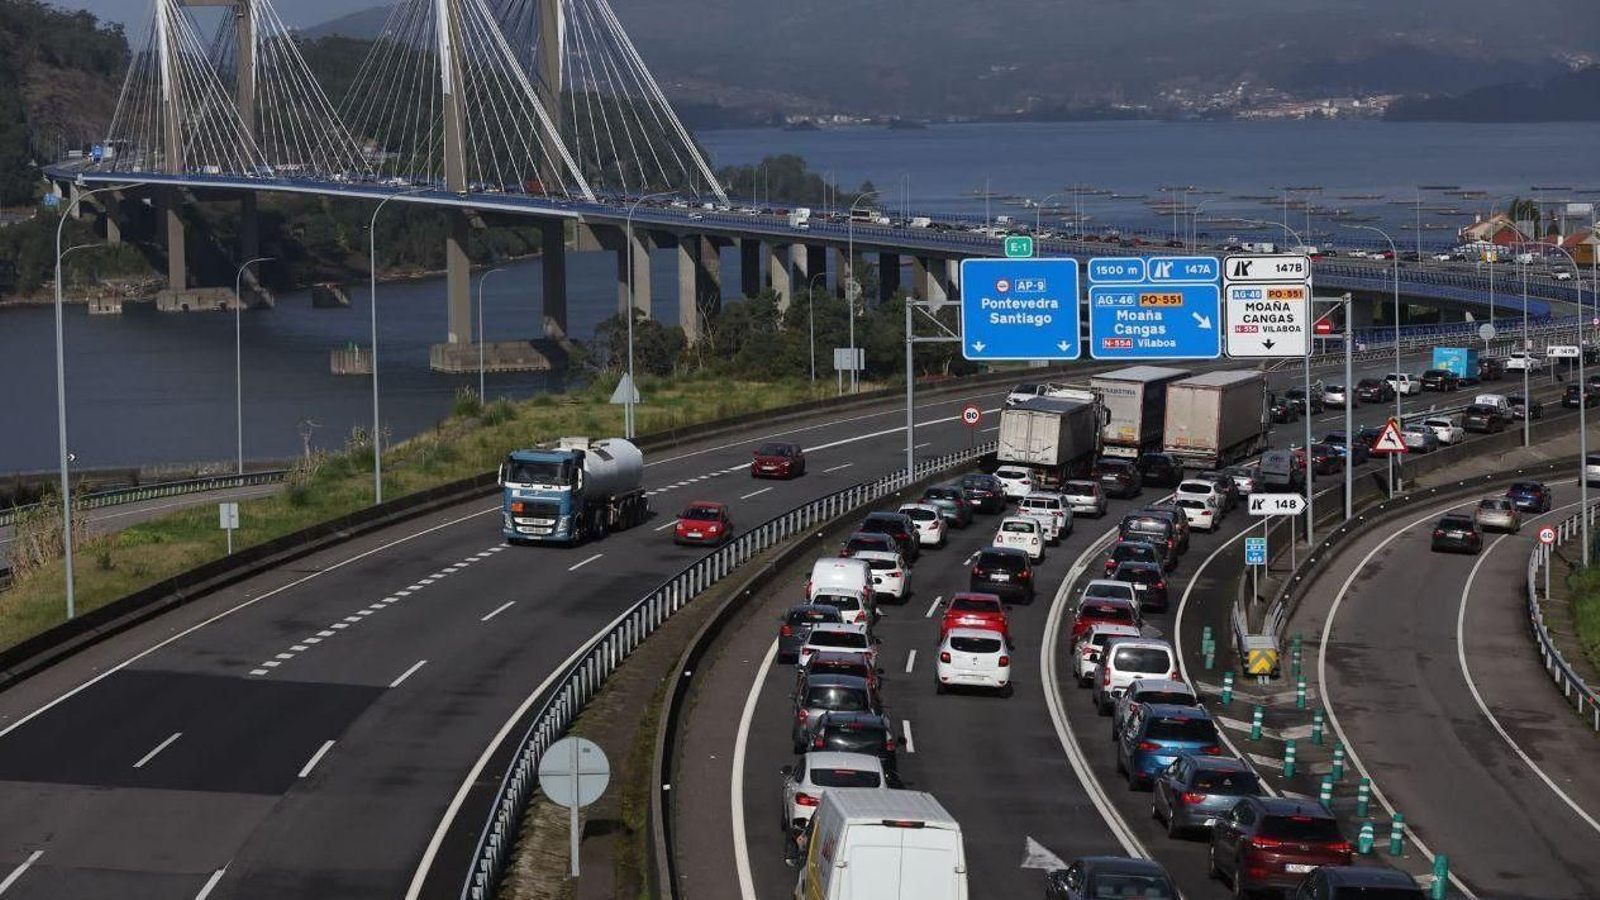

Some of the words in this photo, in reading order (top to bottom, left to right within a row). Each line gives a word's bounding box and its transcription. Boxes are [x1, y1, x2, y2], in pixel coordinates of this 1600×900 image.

[1010, 242, 1028, 252] E-1
[1095, 265, 1124, 274] 1500
[1127, 266, 1138, 274] m
[1185, 264, 1211, 274] 147A
[1275, 264, 1302, 273] 147B
[1017, 281, 1044, 291] AP-9
[1269, 290, 1303, 298] PO-551
[981, 297, 1059, 309] Pontevedra
[1098, 295, 1134, 305] AG-46
[1141, 295, 1182, 304] PO-551
[1245, 300, 1291, 311] MOAÑA
[989, 312, 1052, 326] Santiago
[1116, 309, 1163, 321] Moaña
[1242, 314, 1294, 323] CANGAS
[1114, 323, 1166, 337] Cangas
[1262, 325, 1302, 333] VILABOA
[1137, 338, 1176, 347] Vilaboa
[966, 411, 978, 419] 80
[1275, 499, 1297, 509] 148
